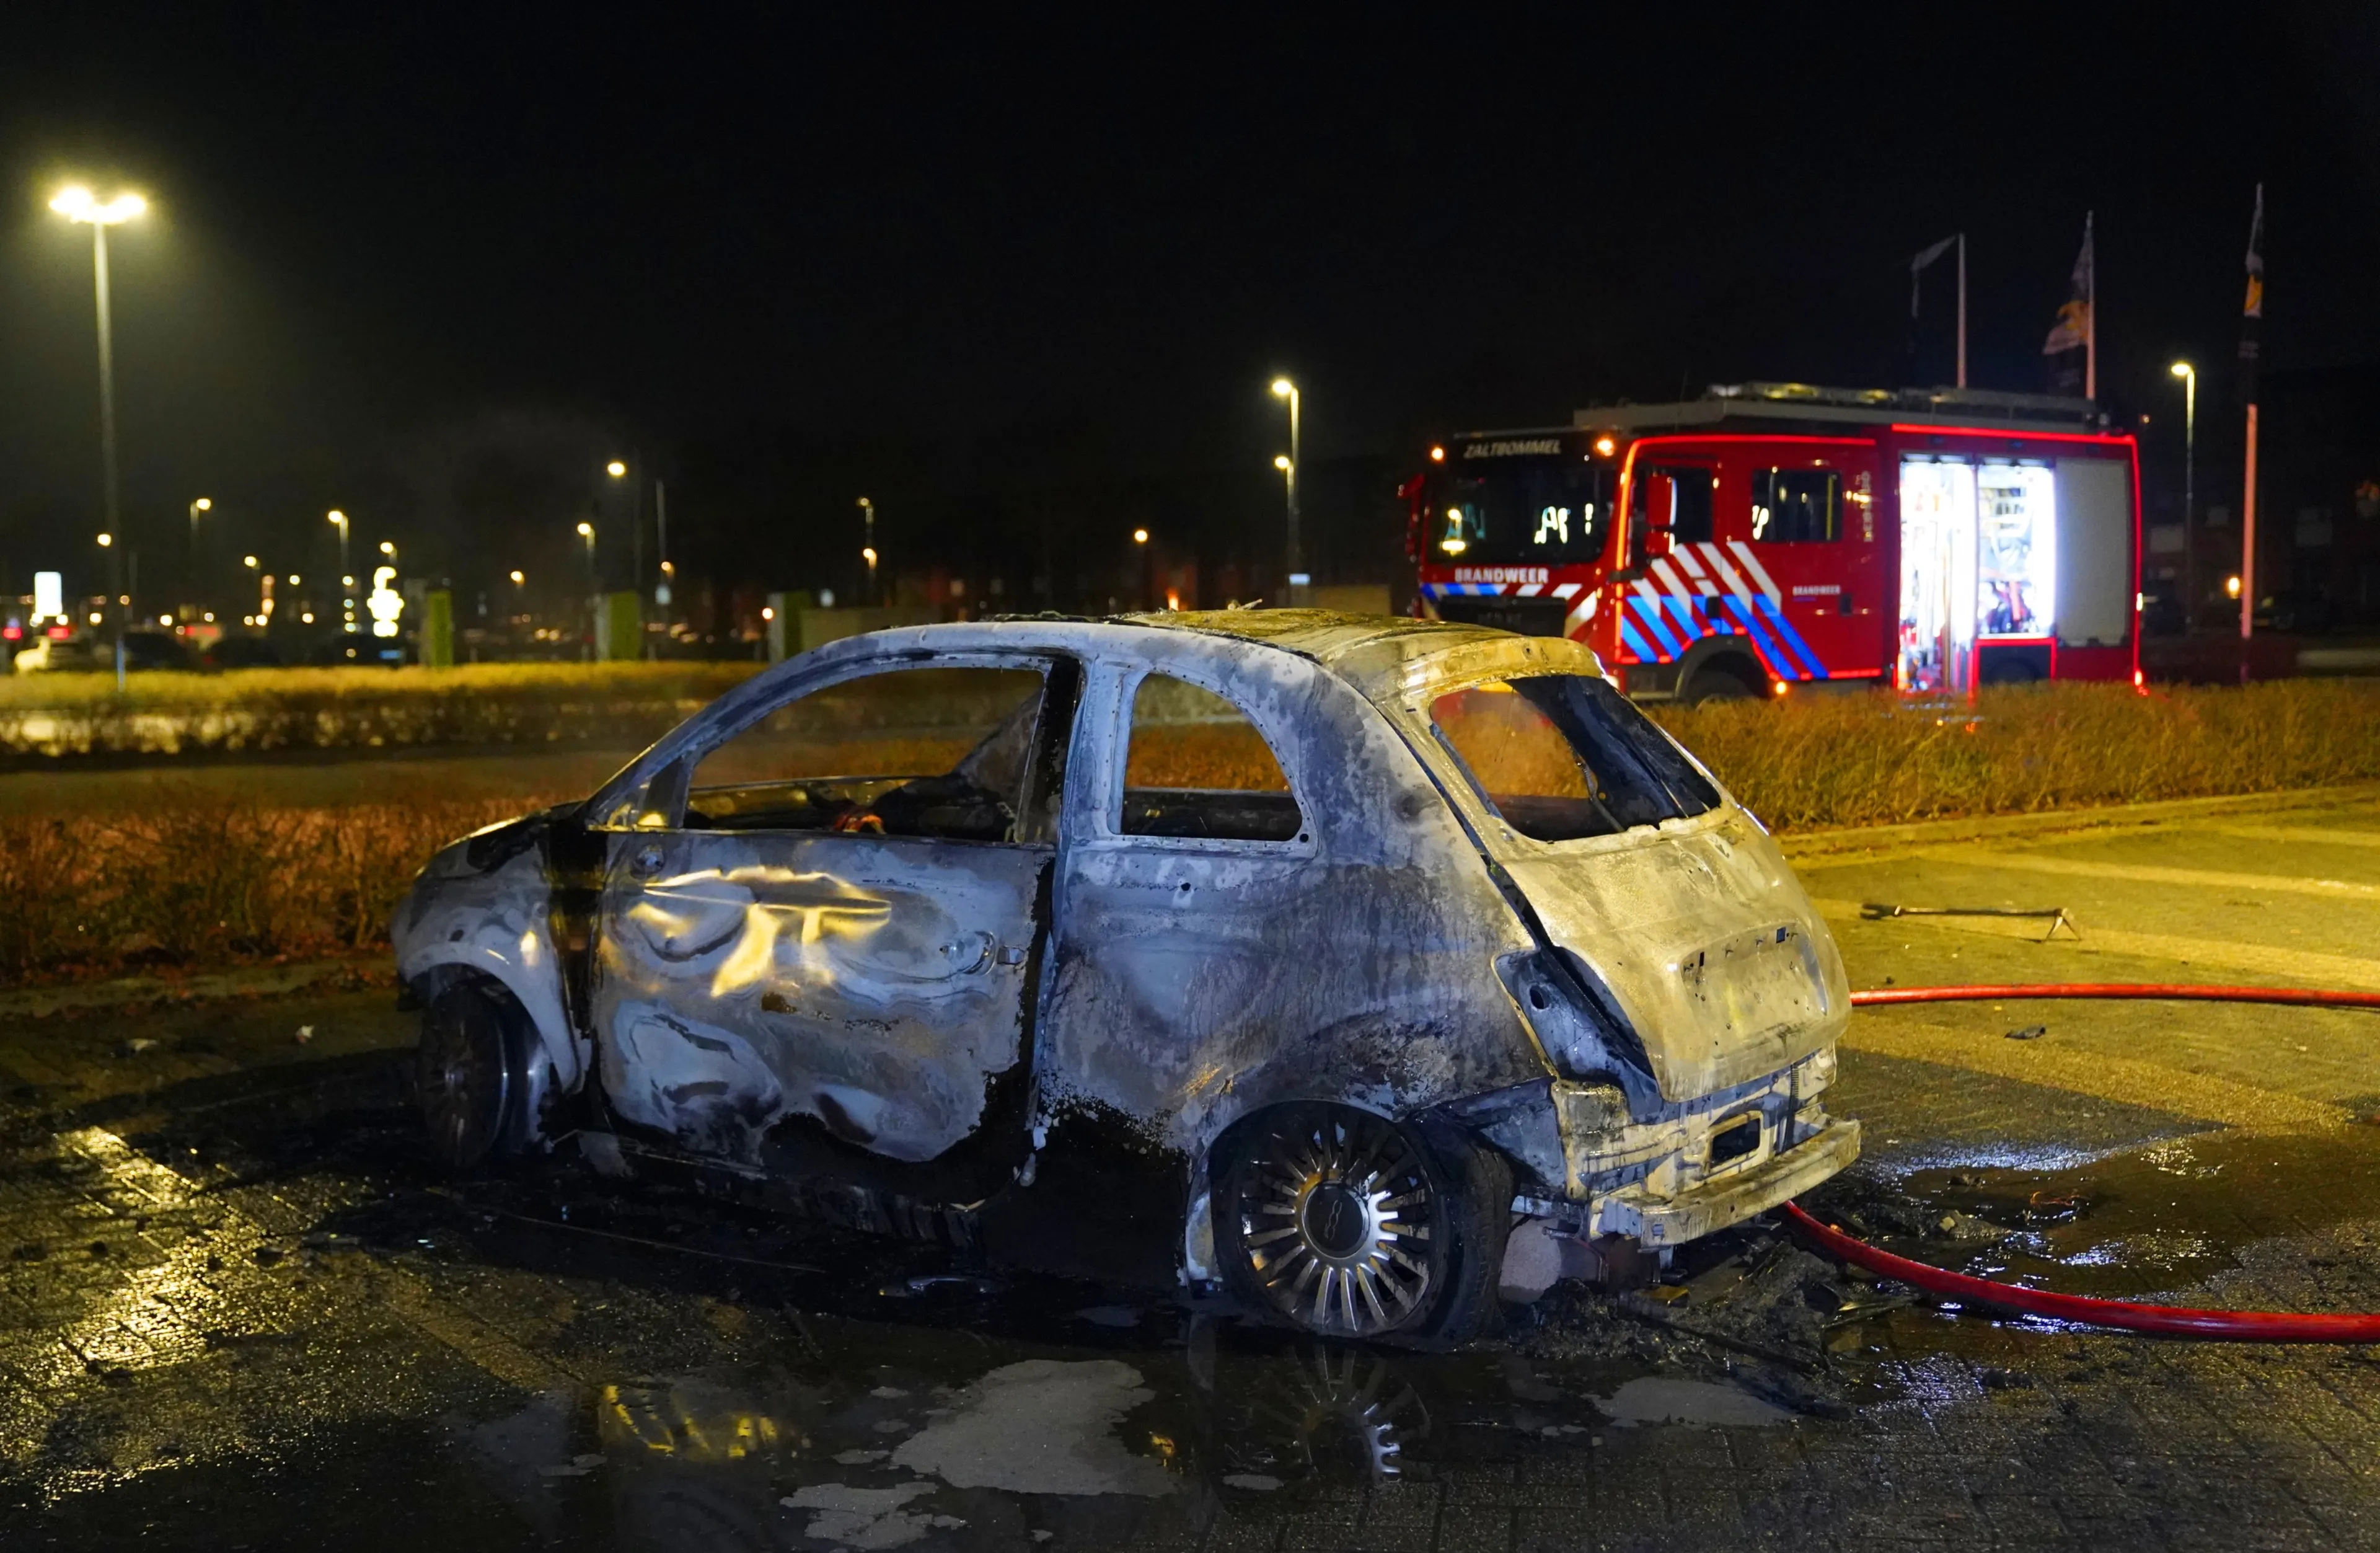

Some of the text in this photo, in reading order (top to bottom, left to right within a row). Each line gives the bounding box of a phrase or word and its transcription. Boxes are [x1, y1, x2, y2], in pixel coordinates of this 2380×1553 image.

[1463, 440, 1561, 459] ZALTBOMMEL
[1455, 567, 1549, 584] BRANDWEER
[1792, 585, 1841, 596] BRANDWEER
